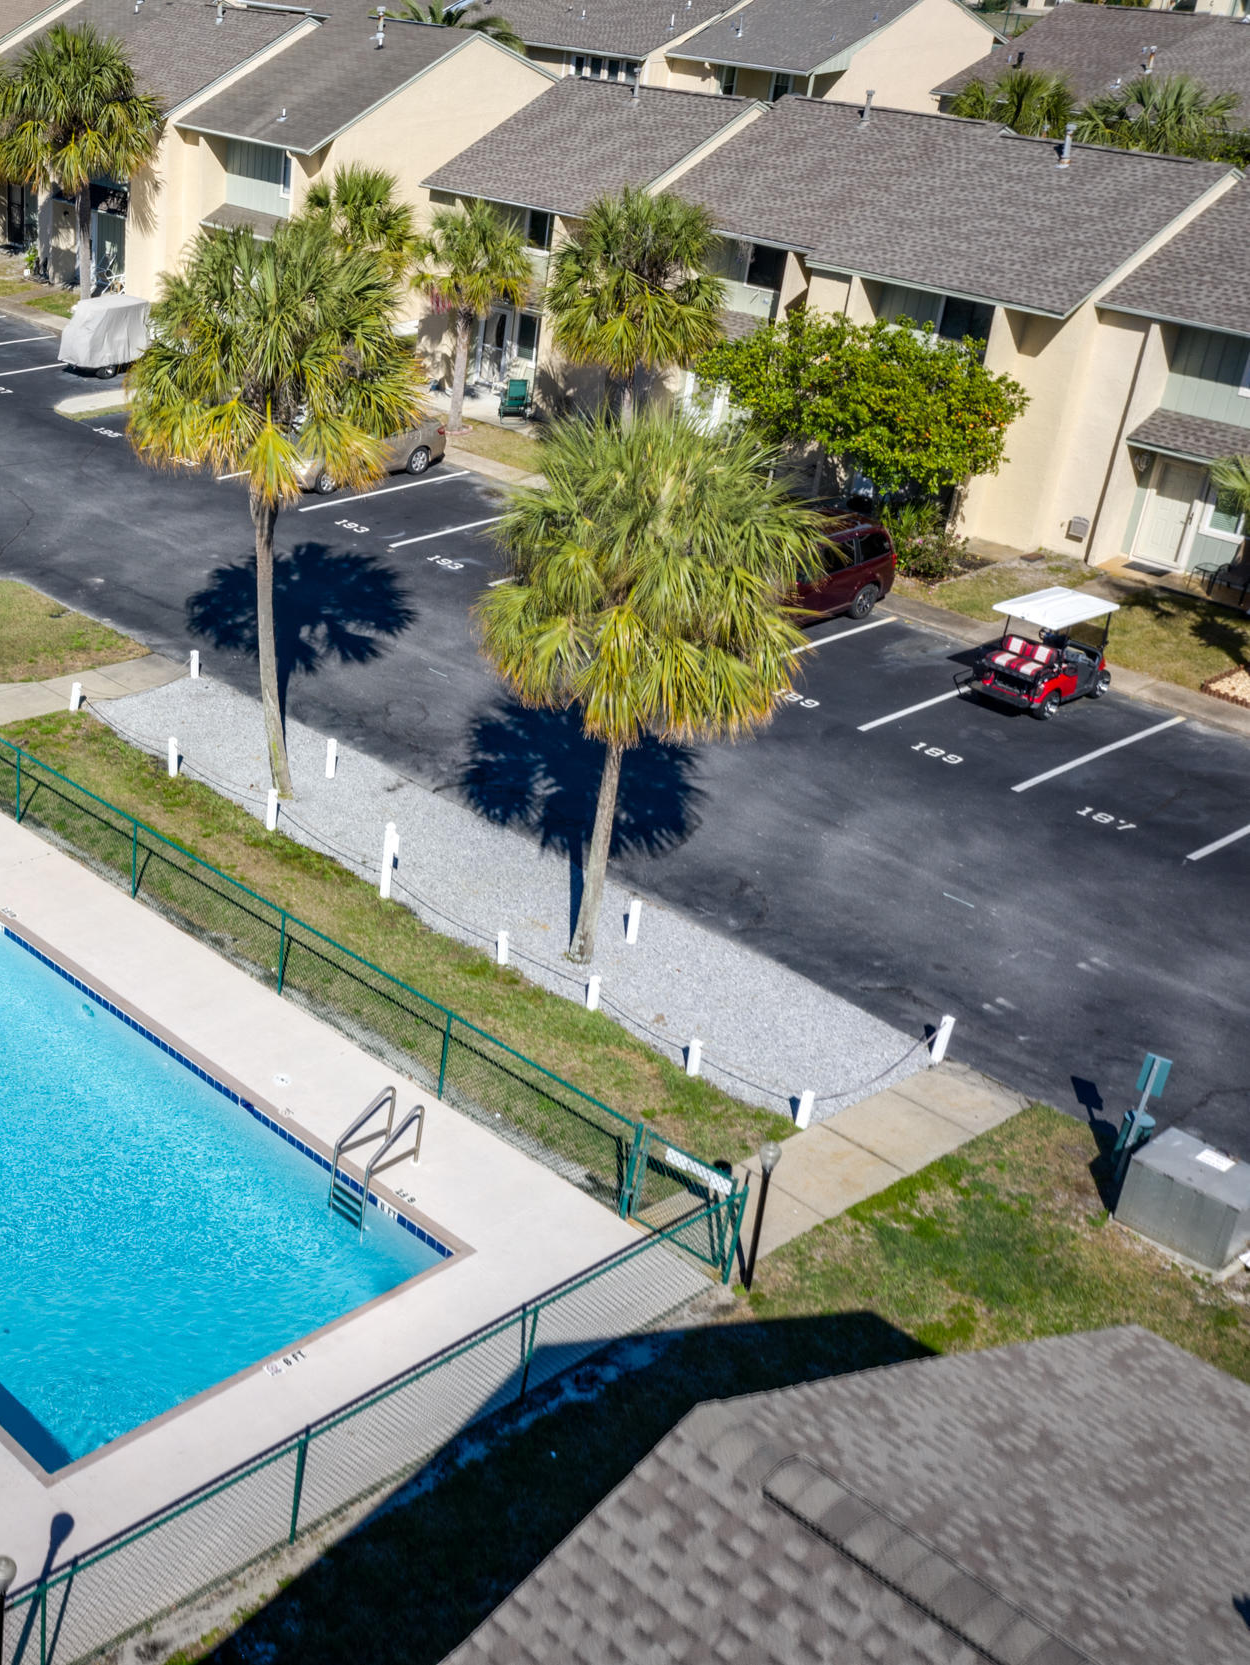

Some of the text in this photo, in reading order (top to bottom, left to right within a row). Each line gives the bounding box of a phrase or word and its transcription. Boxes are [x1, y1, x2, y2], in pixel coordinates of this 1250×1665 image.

[92, 427, 124, 438] 195
[334, 519, 371, 534] 193
[426, 554, 466, 571] 193
[910, 741, 964, 765] 189
[1076, 806, 1137, 831] 187
[387, 1207, 397, 1221] FT
[292, 1350, 306, 1362] FT
